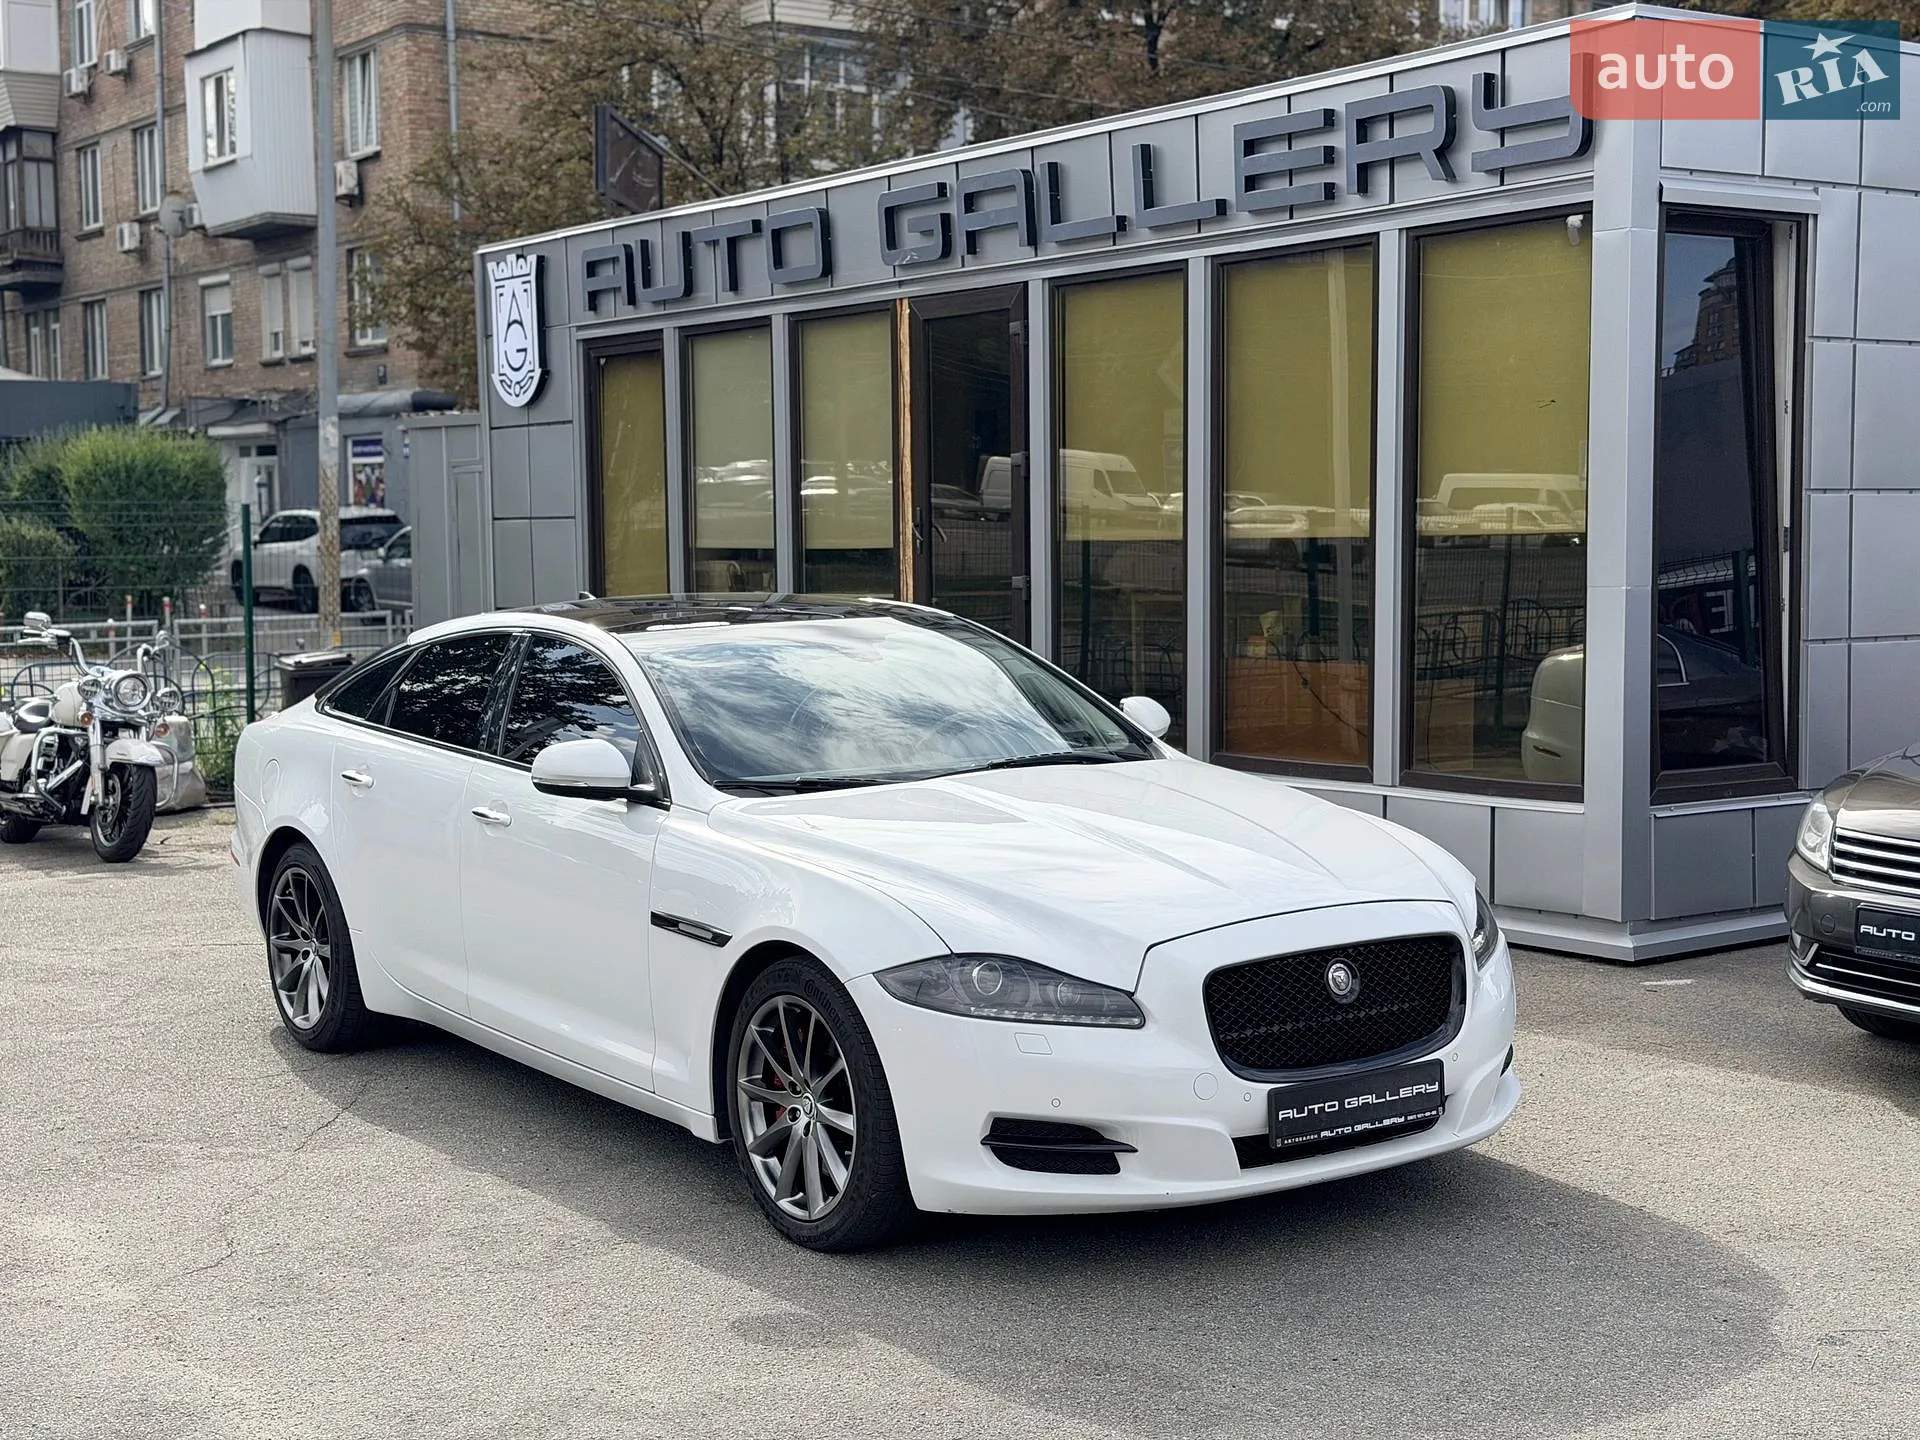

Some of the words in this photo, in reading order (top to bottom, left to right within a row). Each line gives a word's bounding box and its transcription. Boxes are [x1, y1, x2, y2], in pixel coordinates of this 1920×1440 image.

[581, 207, 832, 312] AUTO
[879, 53, 1594, 266] GALLERY
[1860, 925, 1915, 941] AUTO
[1279, 1101, 1339, 1121] AUTO
[1345, 1081, 1439, 1108] GALLERY
[1320, 1127, 1352, 1138] AUTO
[1354, 1116, 1405, 1131] GALLERY
